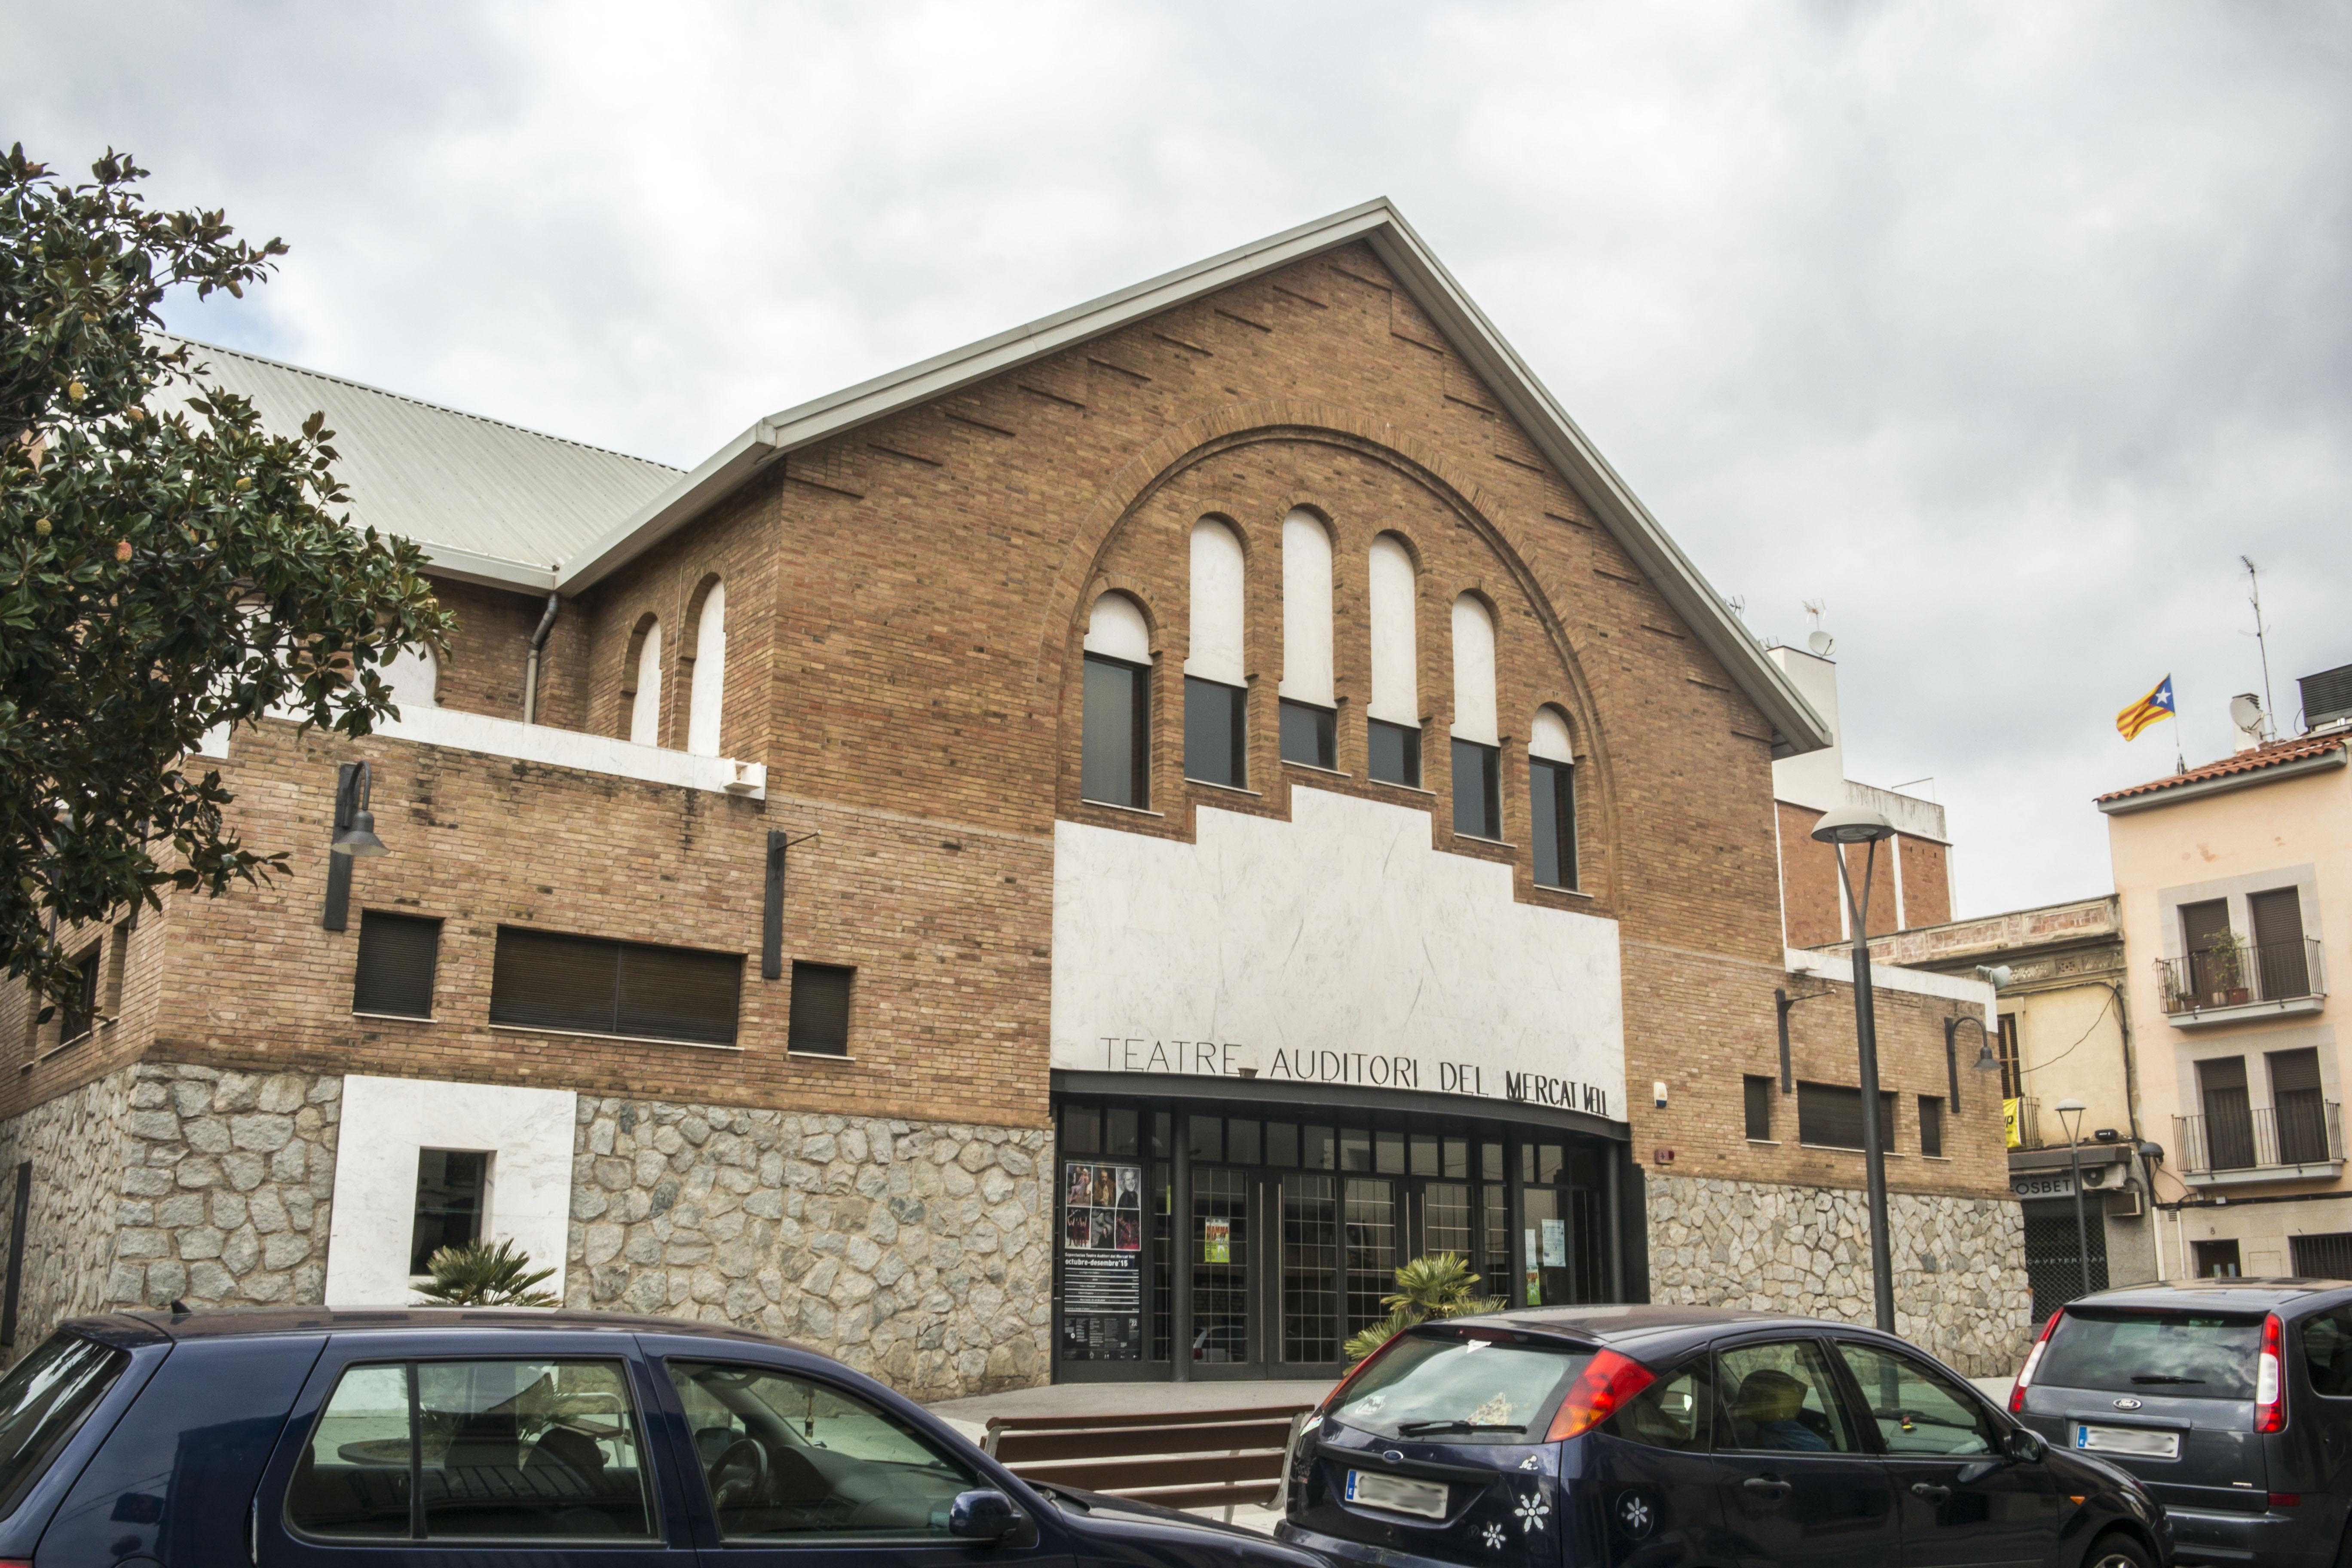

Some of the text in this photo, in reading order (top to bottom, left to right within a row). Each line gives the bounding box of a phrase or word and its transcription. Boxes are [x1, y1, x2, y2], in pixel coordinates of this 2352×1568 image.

[1100, 1037, 1242, 1075] TEATRE
[1270, 1048, 1418, 1087] AUDITORI
[1440, 1062, 1489, 1096] DEL
[1506, 1070, 1577, 1109] MERCAT
[2010, 1179, 2070, 1195] OSBET
